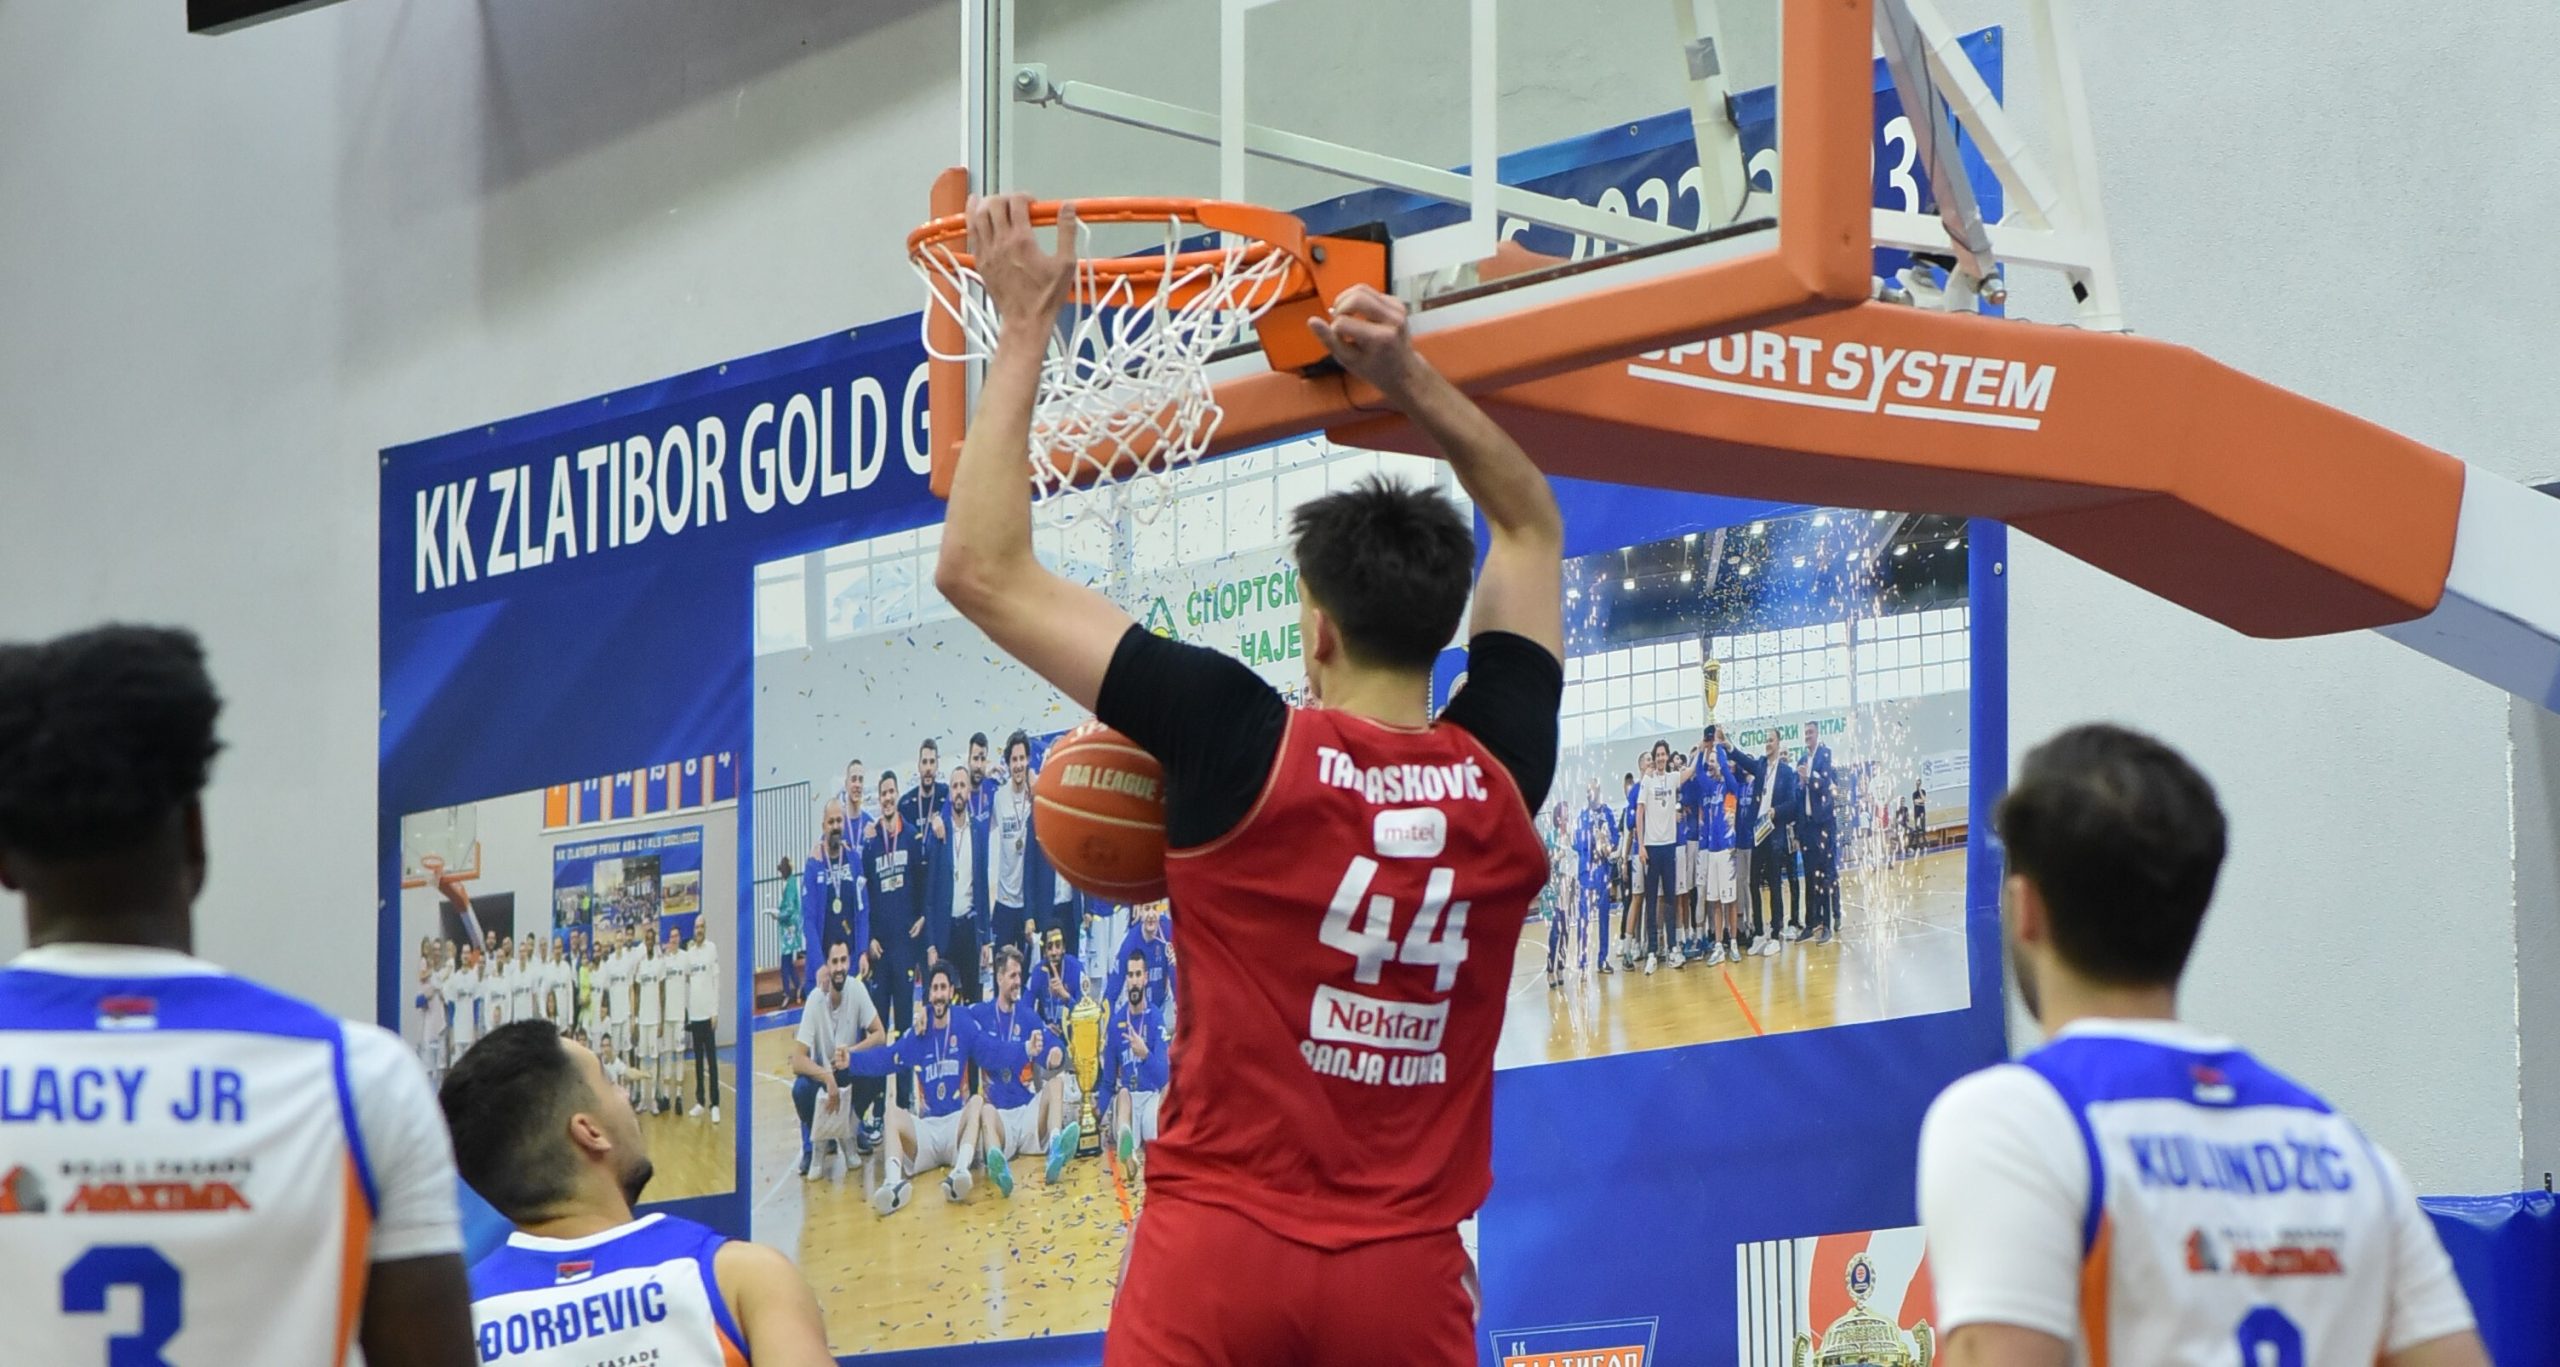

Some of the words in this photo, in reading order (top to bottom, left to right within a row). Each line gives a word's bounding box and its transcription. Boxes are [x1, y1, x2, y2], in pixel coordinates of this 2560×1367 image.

[1825, 341, 2057, 413] SYSTEM
[415, 477, 478, 593] KK
[486, 415, 728, 578] ZLATIBOR
[739, 376, 888, 514] GOLD
[1091, 766, 1158, 801] LEAGUE
[1318, 855, 1470, 992] 44
[1327, 997, 1441, 1042] Nektar
[0, 1067, 146, 1122] LACY
[171, 1067, 247, 1122] JR
[61, 1244, 183, 1367] 3
[476, 1274, 668, 1363] ĐORĐEVIĆ
